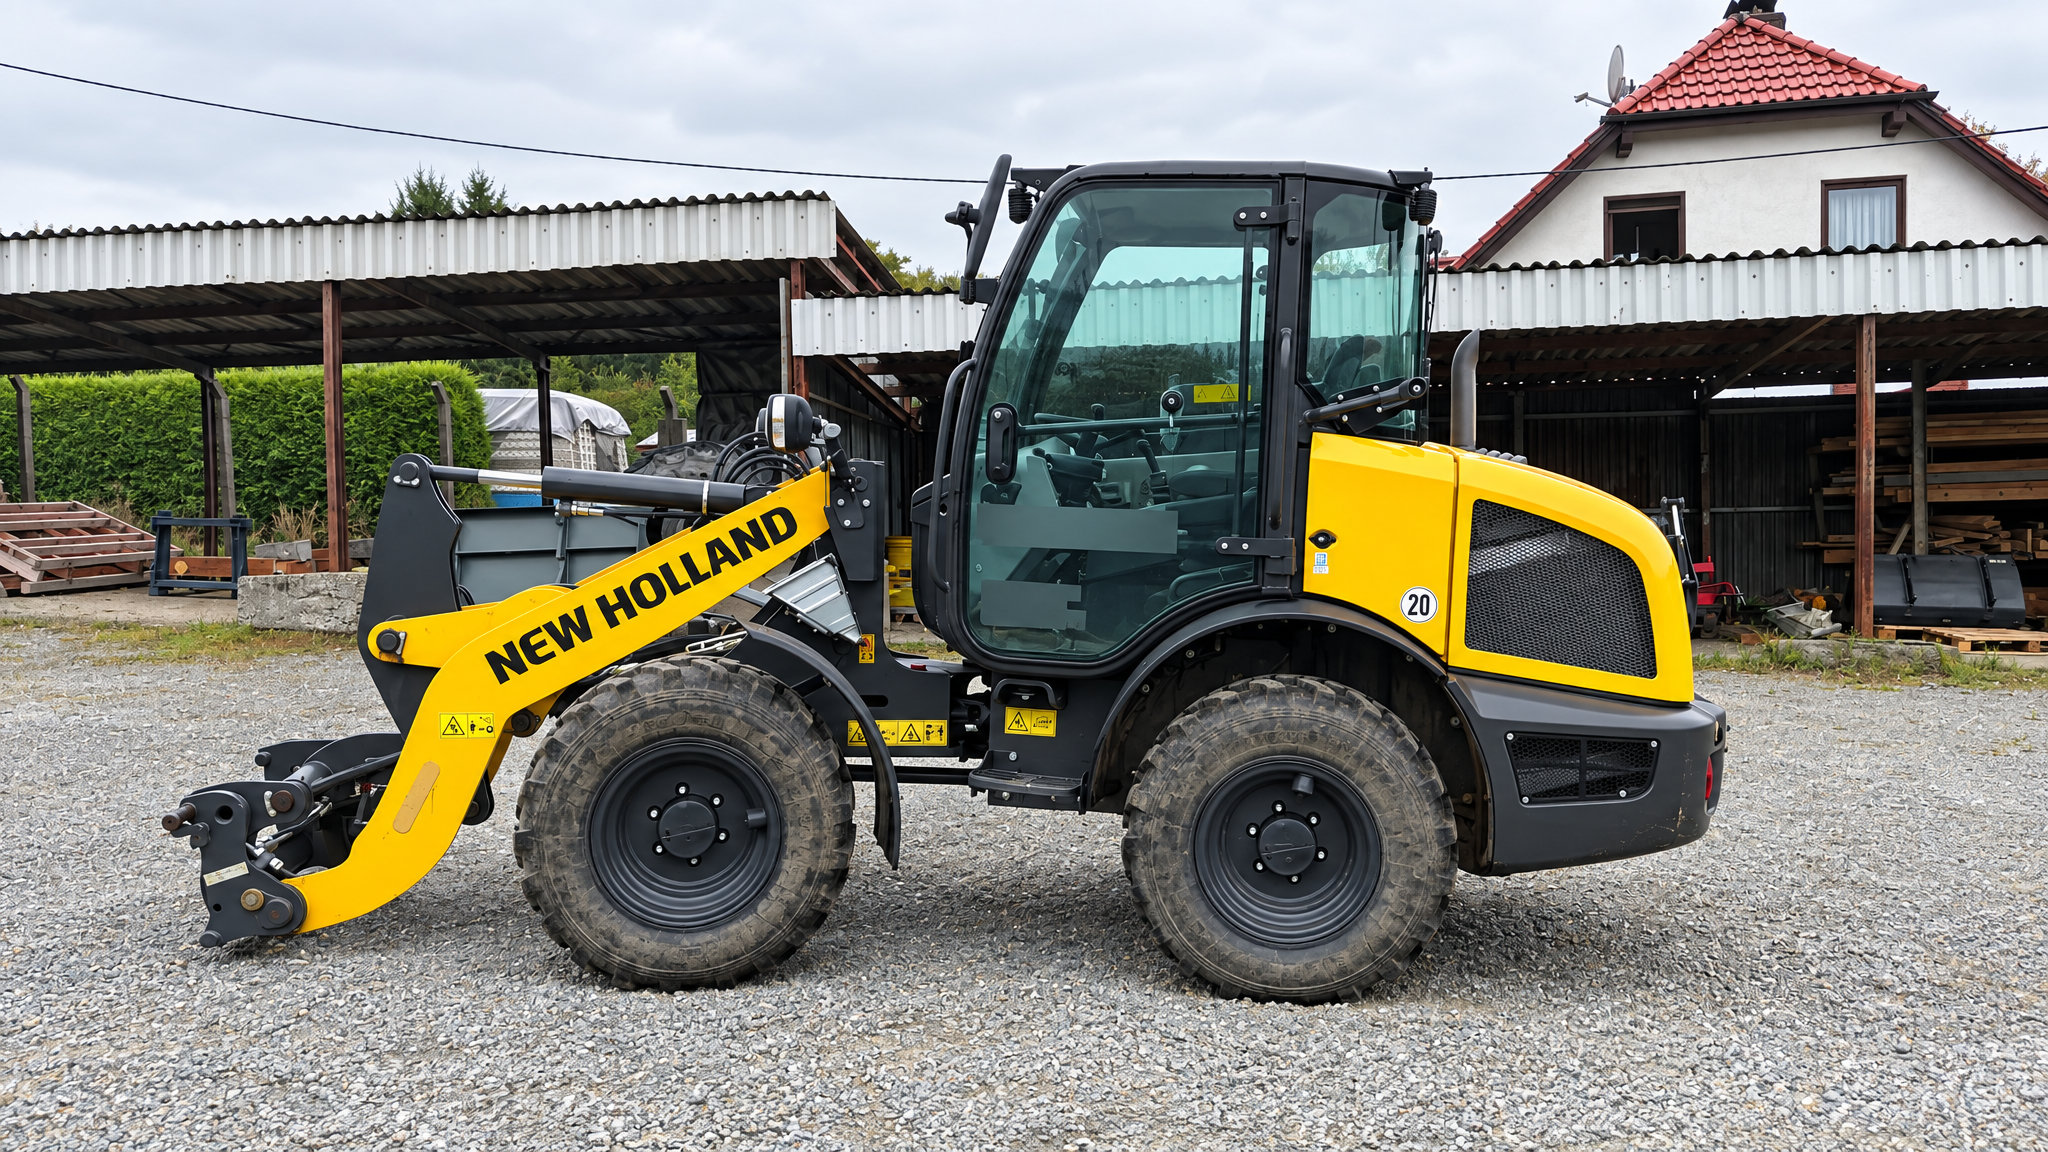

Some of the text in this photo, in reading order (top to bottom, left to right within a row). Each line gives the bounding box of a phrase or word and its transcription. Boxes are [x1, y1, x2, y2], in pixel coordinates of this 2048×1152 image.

[484, 506, 798, 685] NEW HOLLAND
[1407, 593, 1430, 617] 20
